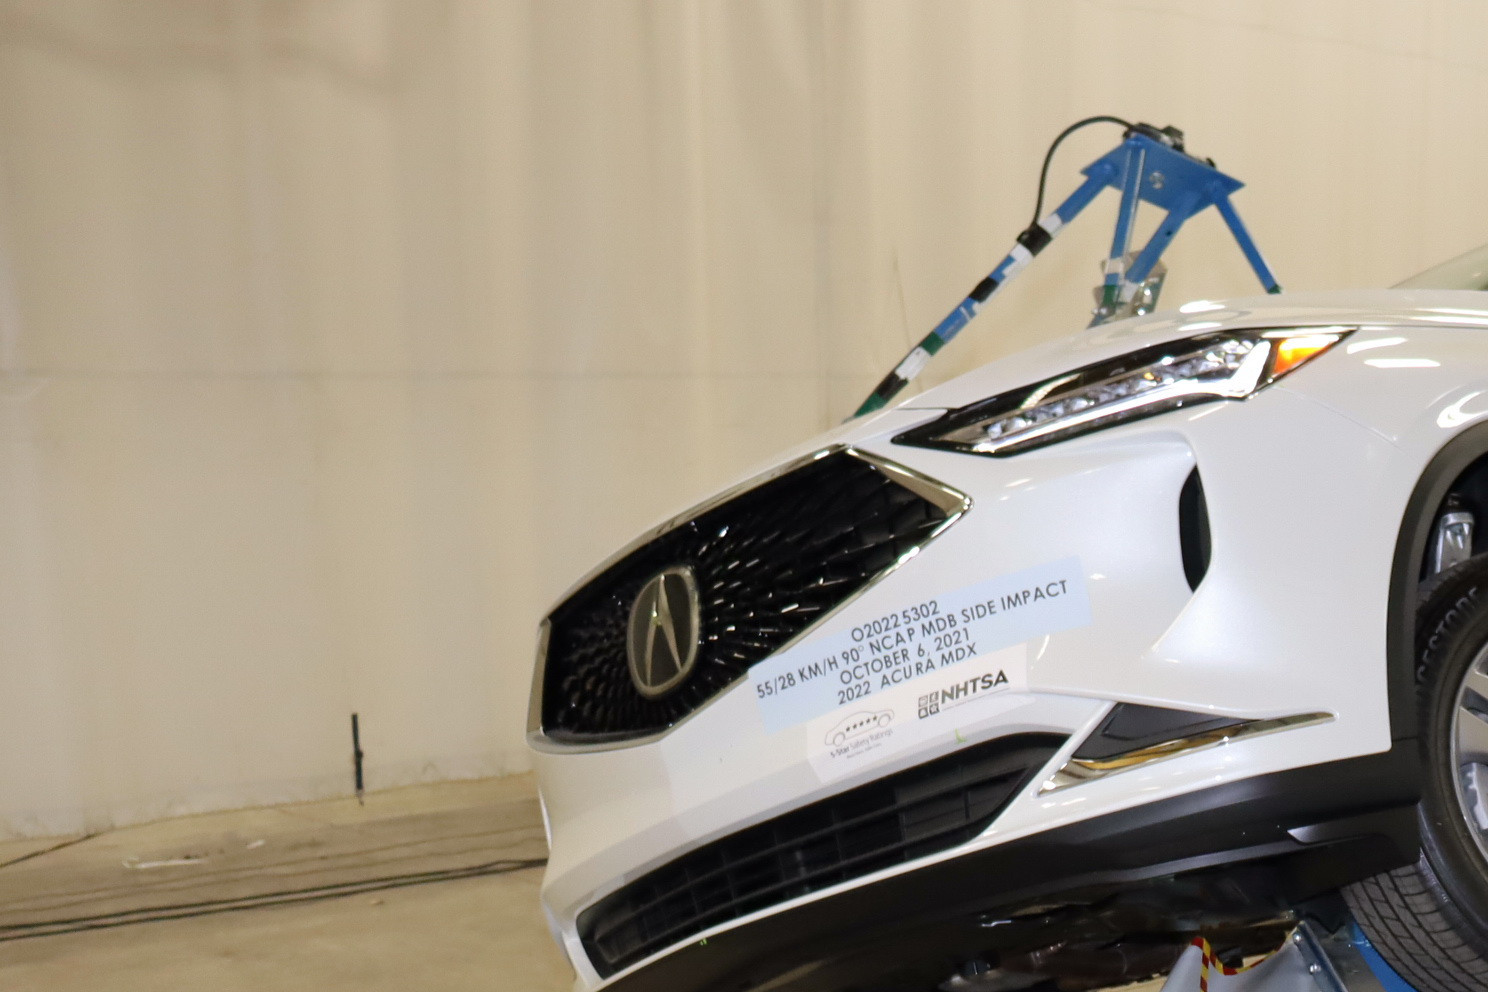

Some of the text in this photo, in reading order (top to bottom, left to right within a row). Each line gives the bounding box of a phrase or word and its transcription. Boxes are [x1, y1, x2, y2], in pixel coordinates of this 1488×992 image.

[756, 579, 1069, 700] 55/28 KM/H 90° NCAP MDB SIDE IMPACT
[839, 627, 971, 686] OCTOBER 6, 2021
[837, 642, 978, 706] 2022 ACURA MDX
[940, 669, 1009, 705] NHTSA
